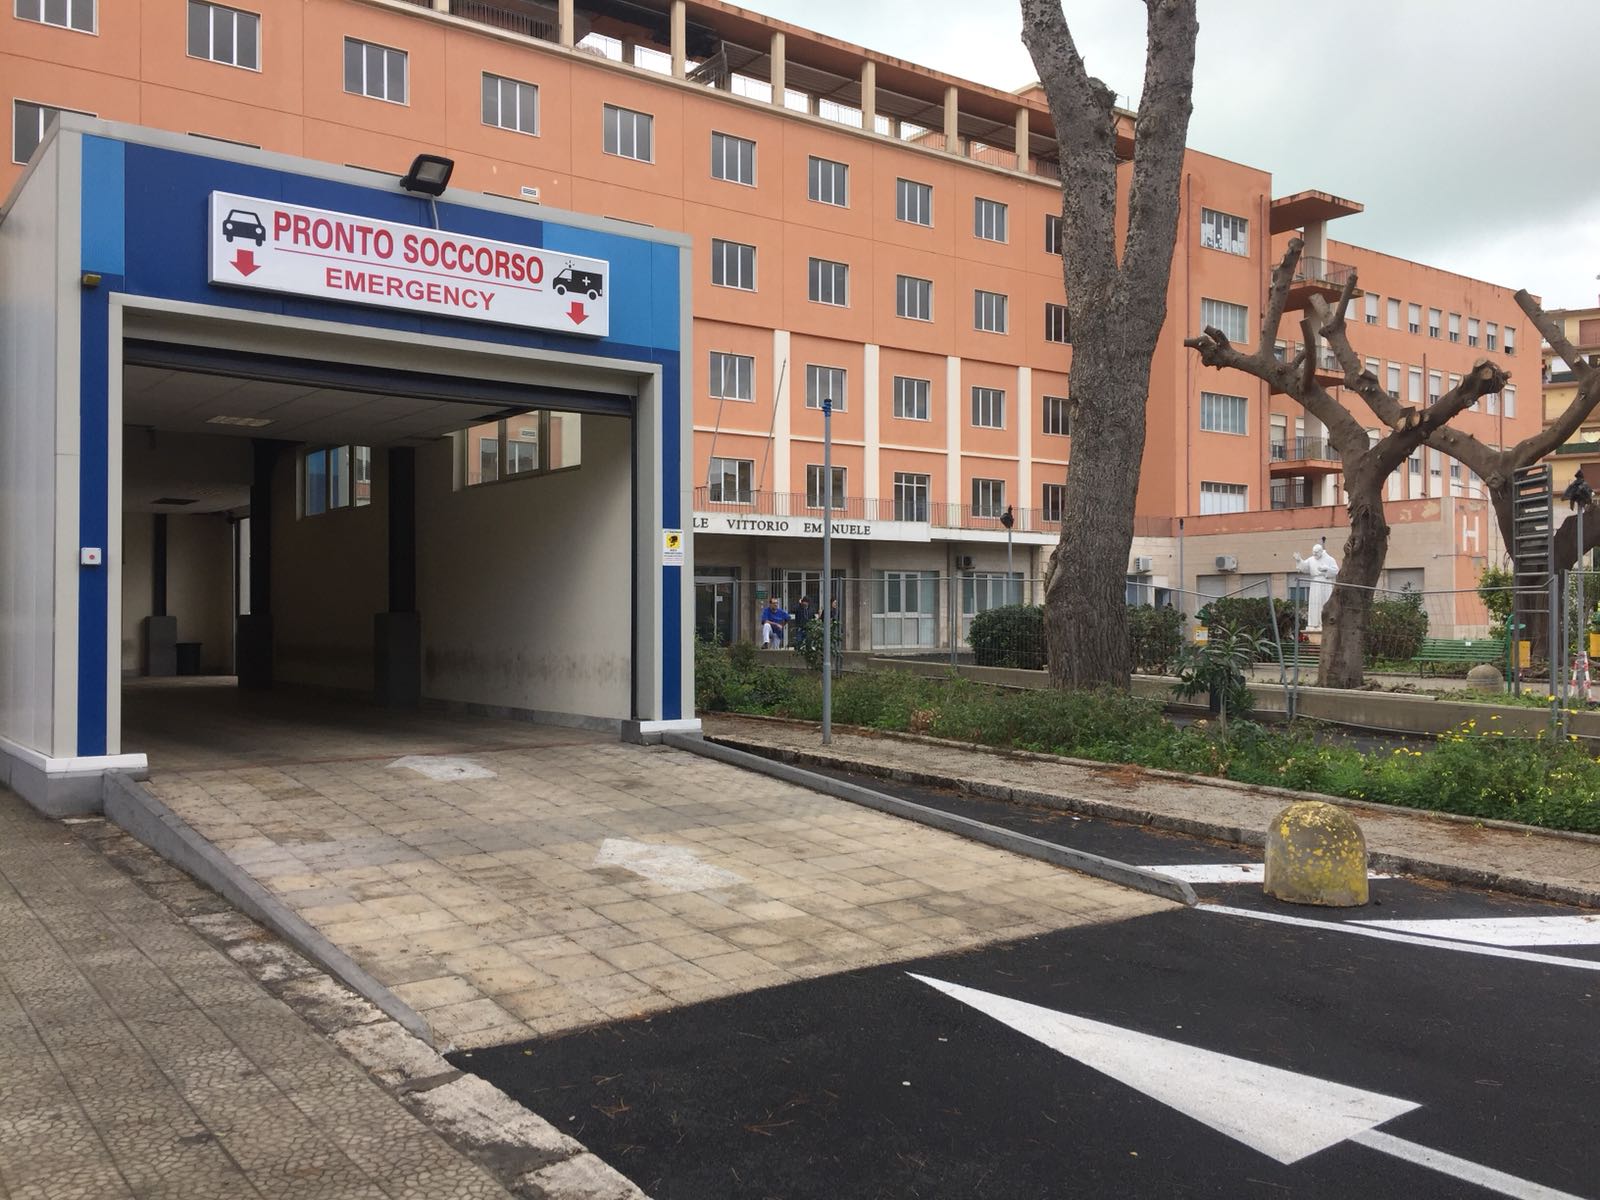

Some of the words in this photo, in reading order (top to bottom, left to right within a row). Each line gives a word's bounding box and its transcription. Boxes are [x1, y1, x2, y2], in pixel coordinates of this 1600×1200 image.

[273, 210, 394, 260] PRONTO
[403, 234, 544, 285] SOCCORSO
[326, 267, 495, 311] EMERGENCY
[727, 519, 789, 532] VITTORIO
[803, 522, 872, 535] EMNUELE
